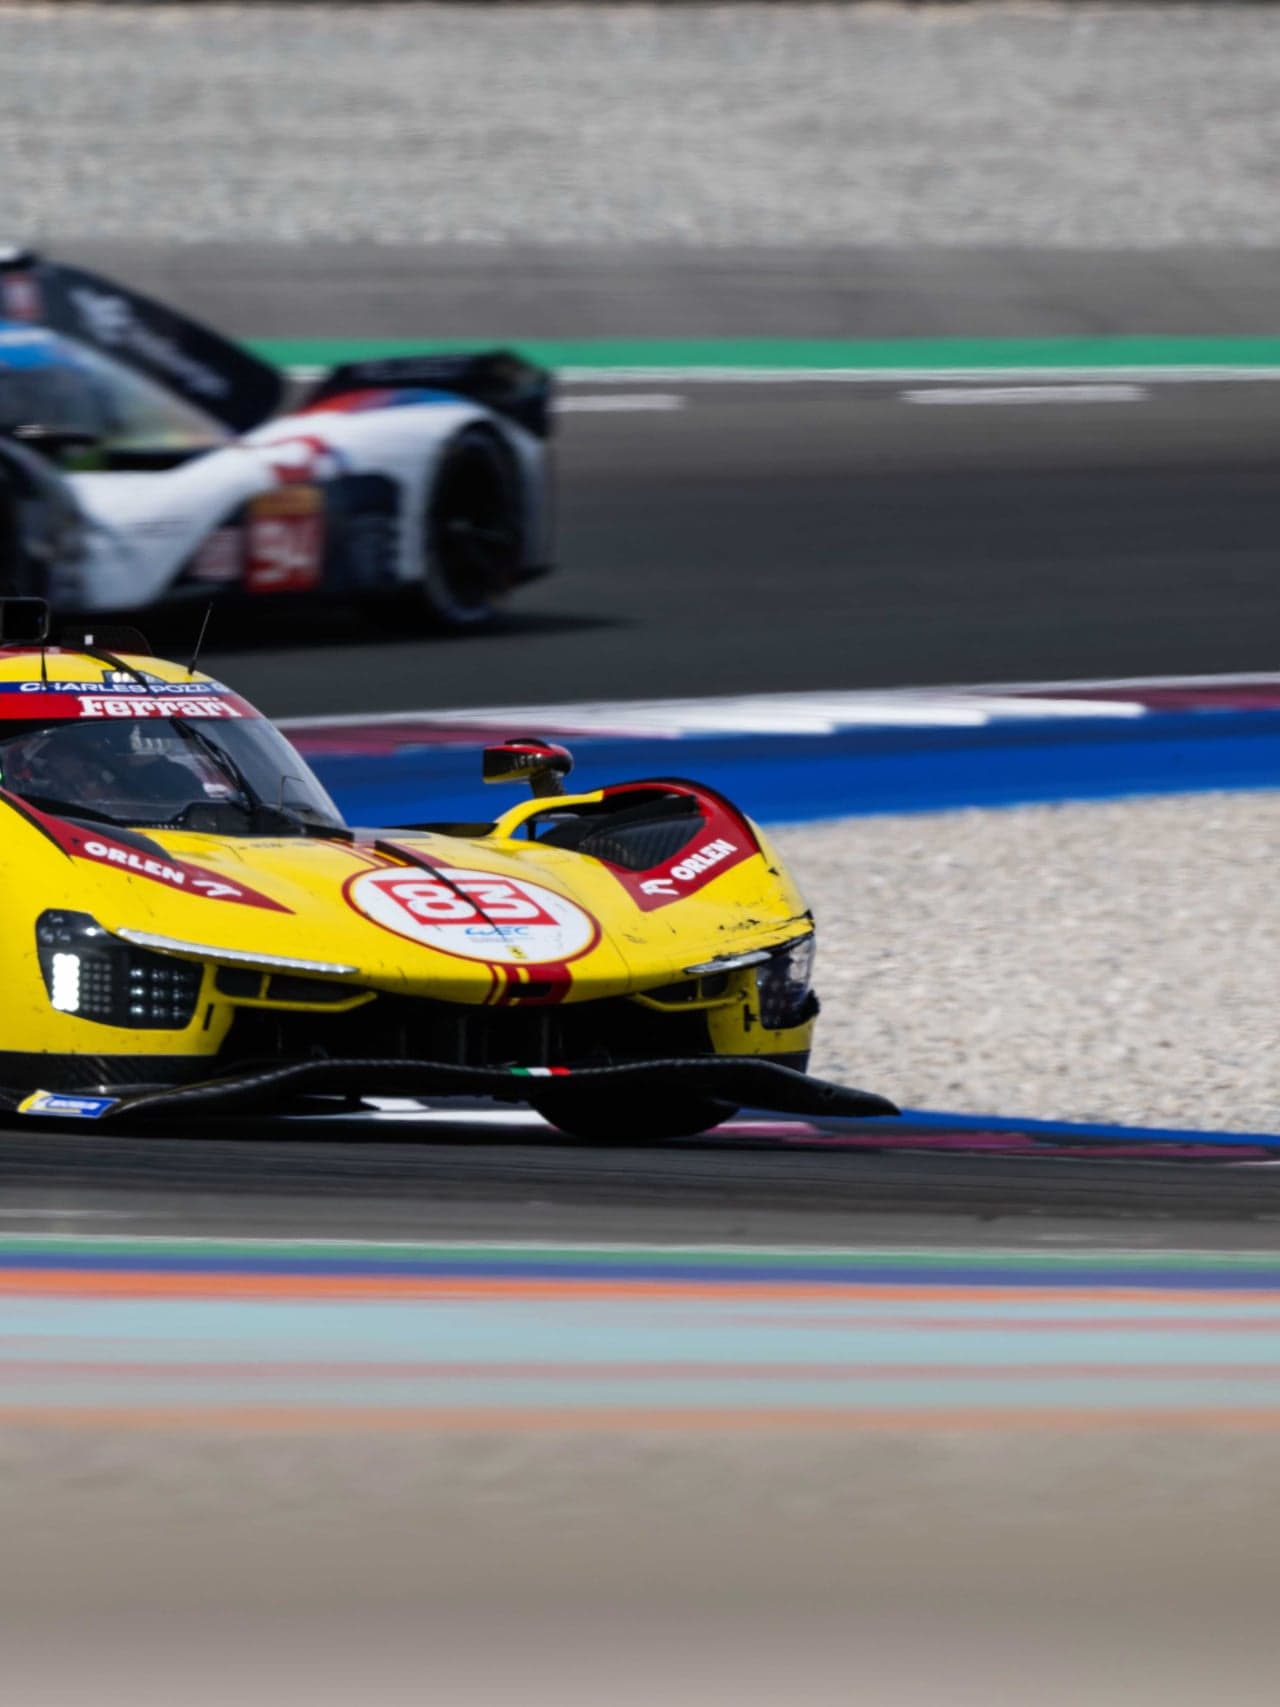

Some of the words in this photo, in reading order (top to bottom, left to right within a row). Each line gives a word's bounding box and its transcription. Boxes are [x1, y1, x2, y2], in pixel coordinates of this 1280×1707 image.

[19, 682, 147, 693] CHARLES
[149, 684, 211, 693] POZZI
[77, 696, 242, 717] Ferrari
[83, 841, 185, 884] ORLEN
[670, 838, 739, 880] ORLEN
[391, 883, 541, 919] 83
